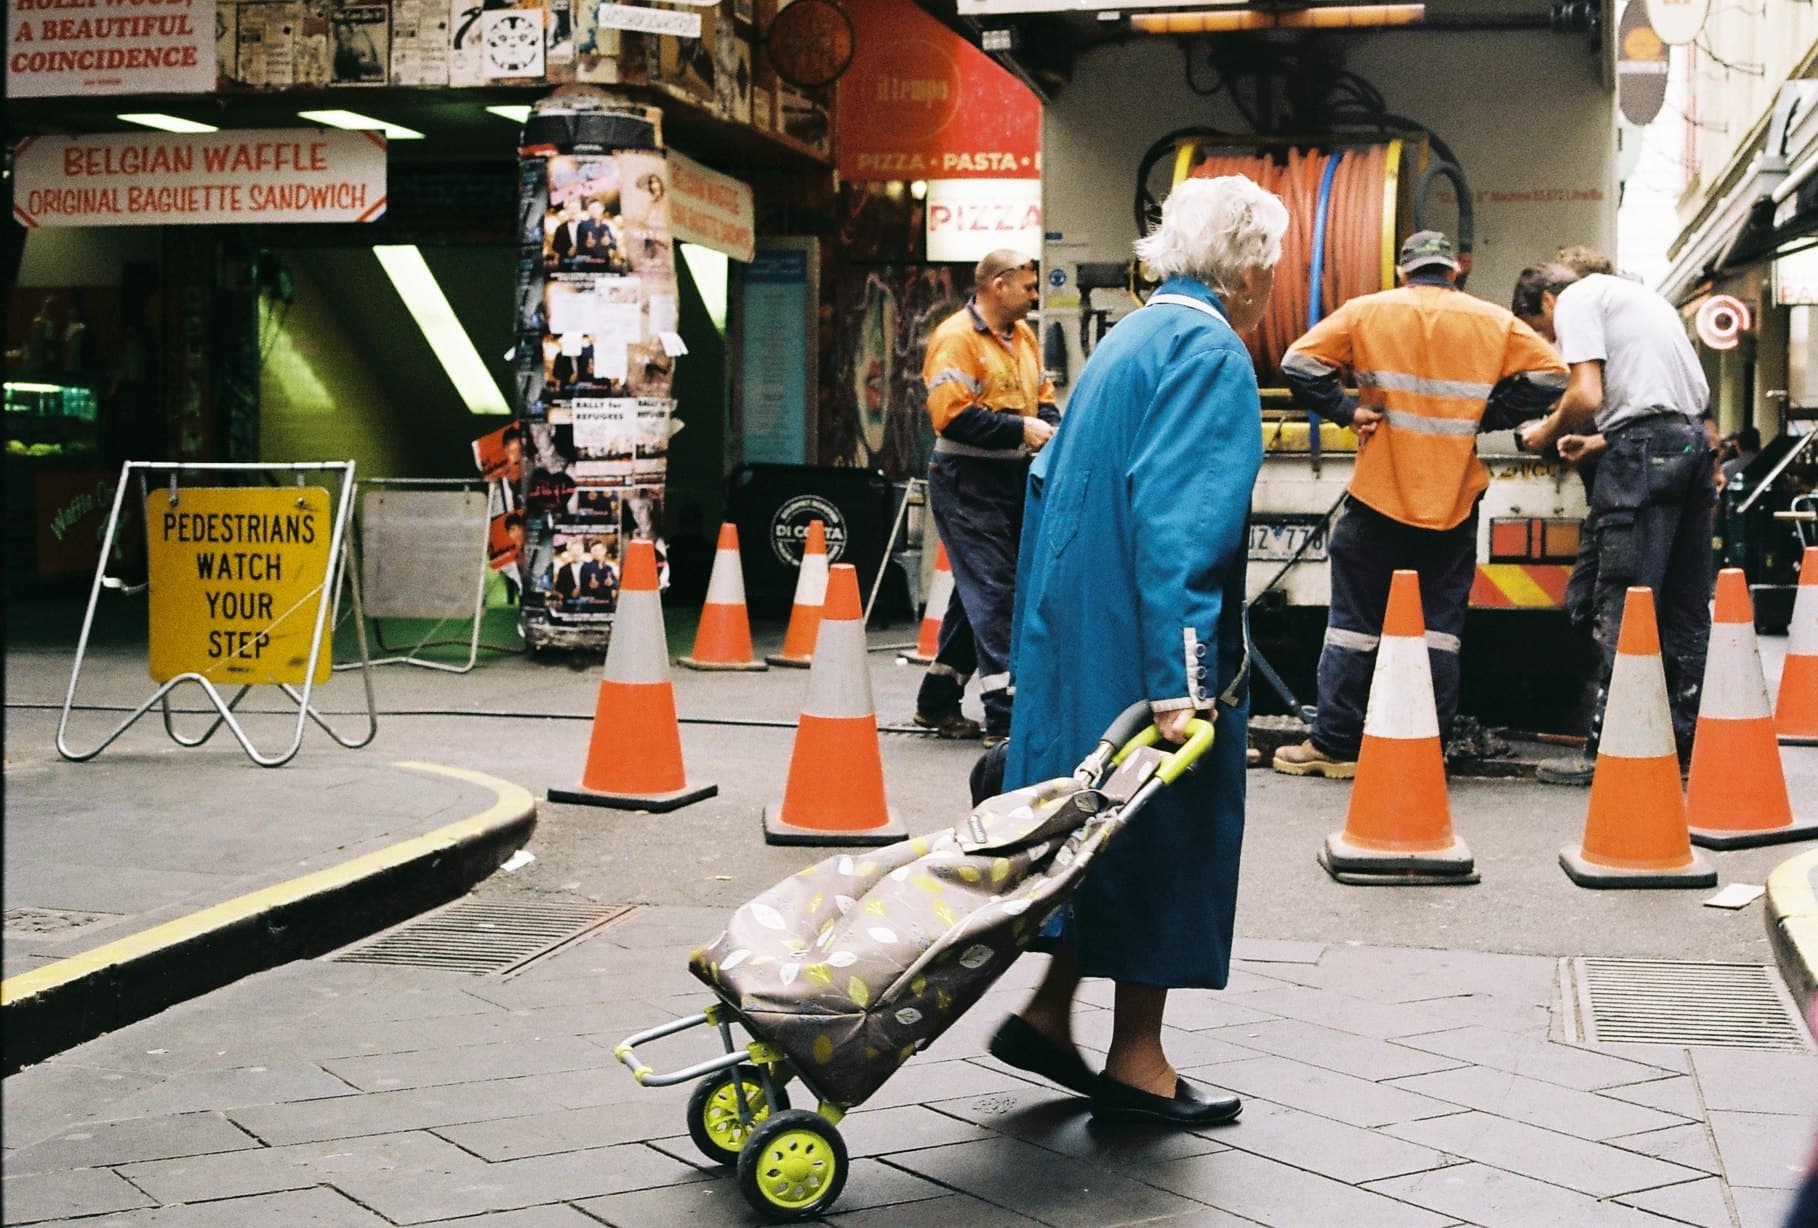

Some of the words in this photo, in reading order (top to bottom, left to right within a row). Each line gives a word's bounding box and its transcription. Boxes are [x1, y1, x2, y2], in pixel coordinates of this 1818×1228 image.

[14, 21, 34, 42] A
[41, 15, 193, 41] BEAUTIFUL
[11, 46, 198, 73] COINCIDENCE
[64, 146, 193, 177] BELGIAN
[203, 143, 328, 173] WAFFLE
[858, 153, 925, 172] PIZZA
[942, 152, 1018, 171] PASTA
[28, 188, 120, 216] ORIGINAL
[127, 185, 243, 214] BAGUETTE
[248, 183, 367, 212] SANDWICH
[929, 204, 1042, 232] PIZZA
[164, 513, 315, 543] PEDESTRIANS
[775, 524, 792, 537] DI
[196, 553, 281, 581] WATCH
[205, 591, 273, 619] YOUR
[208, 631, 270, 659] STEP
